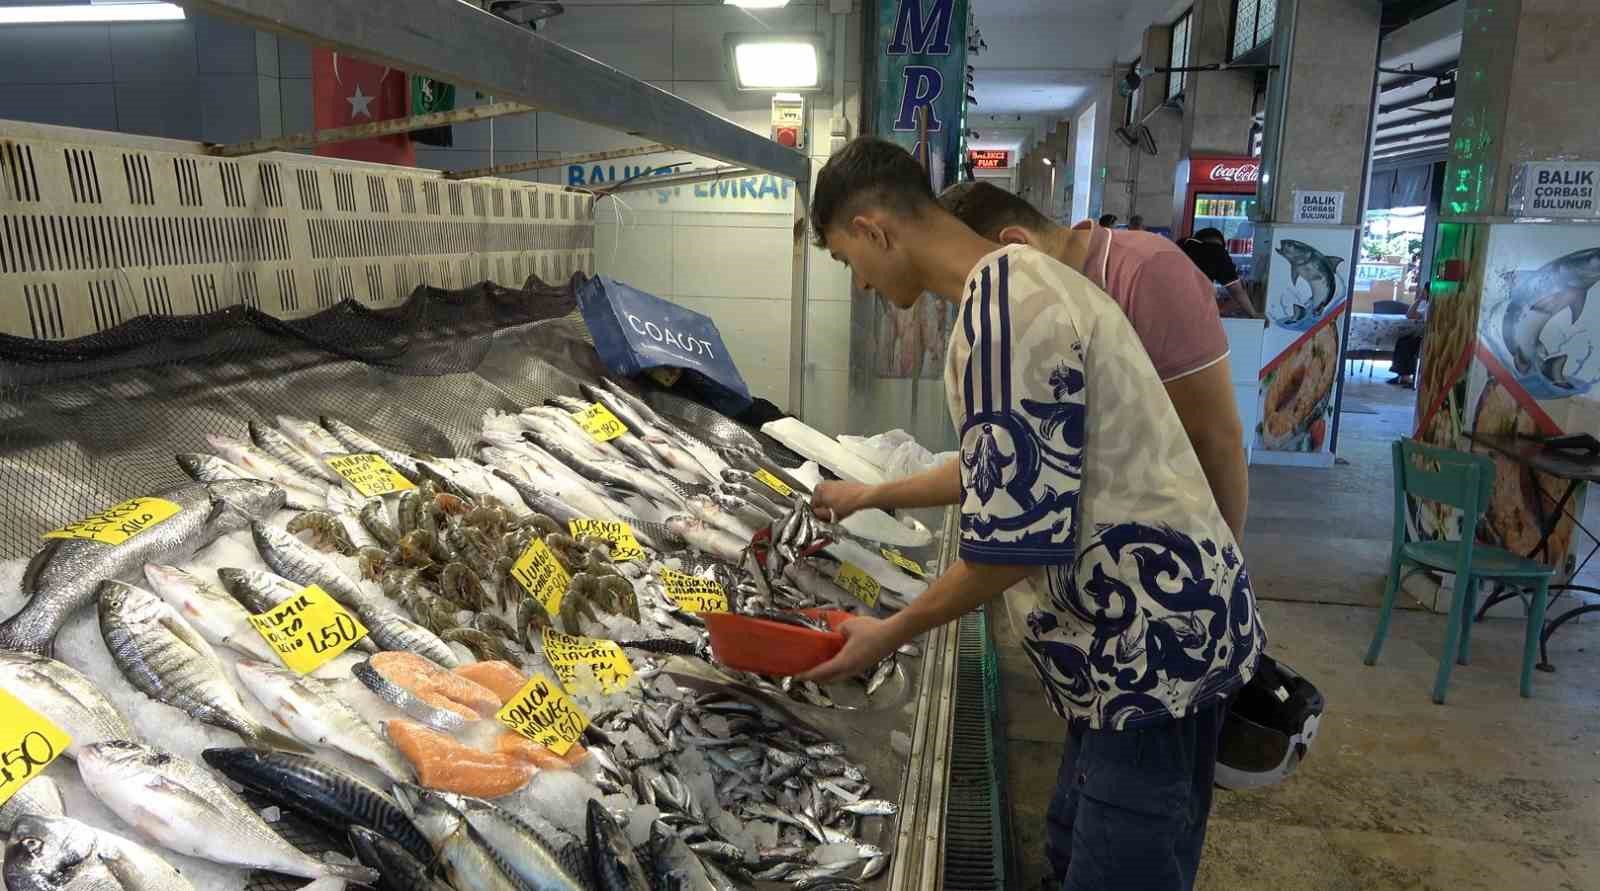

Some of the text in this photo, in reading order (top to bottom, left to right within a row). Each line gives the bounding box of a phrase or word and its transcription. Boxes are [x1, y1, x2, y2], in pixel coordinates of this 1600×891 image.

[978, 159, 998, 167] FUAT
[1210, 164, 1259, 181] Coca-Cola
[1539, 170, 1594, 185] BALIK
[1535, 186, 1593, 199] ÇORBASI
[1303, 195, 1336, 205] BALIK
[1532, 199, 1593, 209] BULUNUR
[501, 681, 549, 729] SOMON
